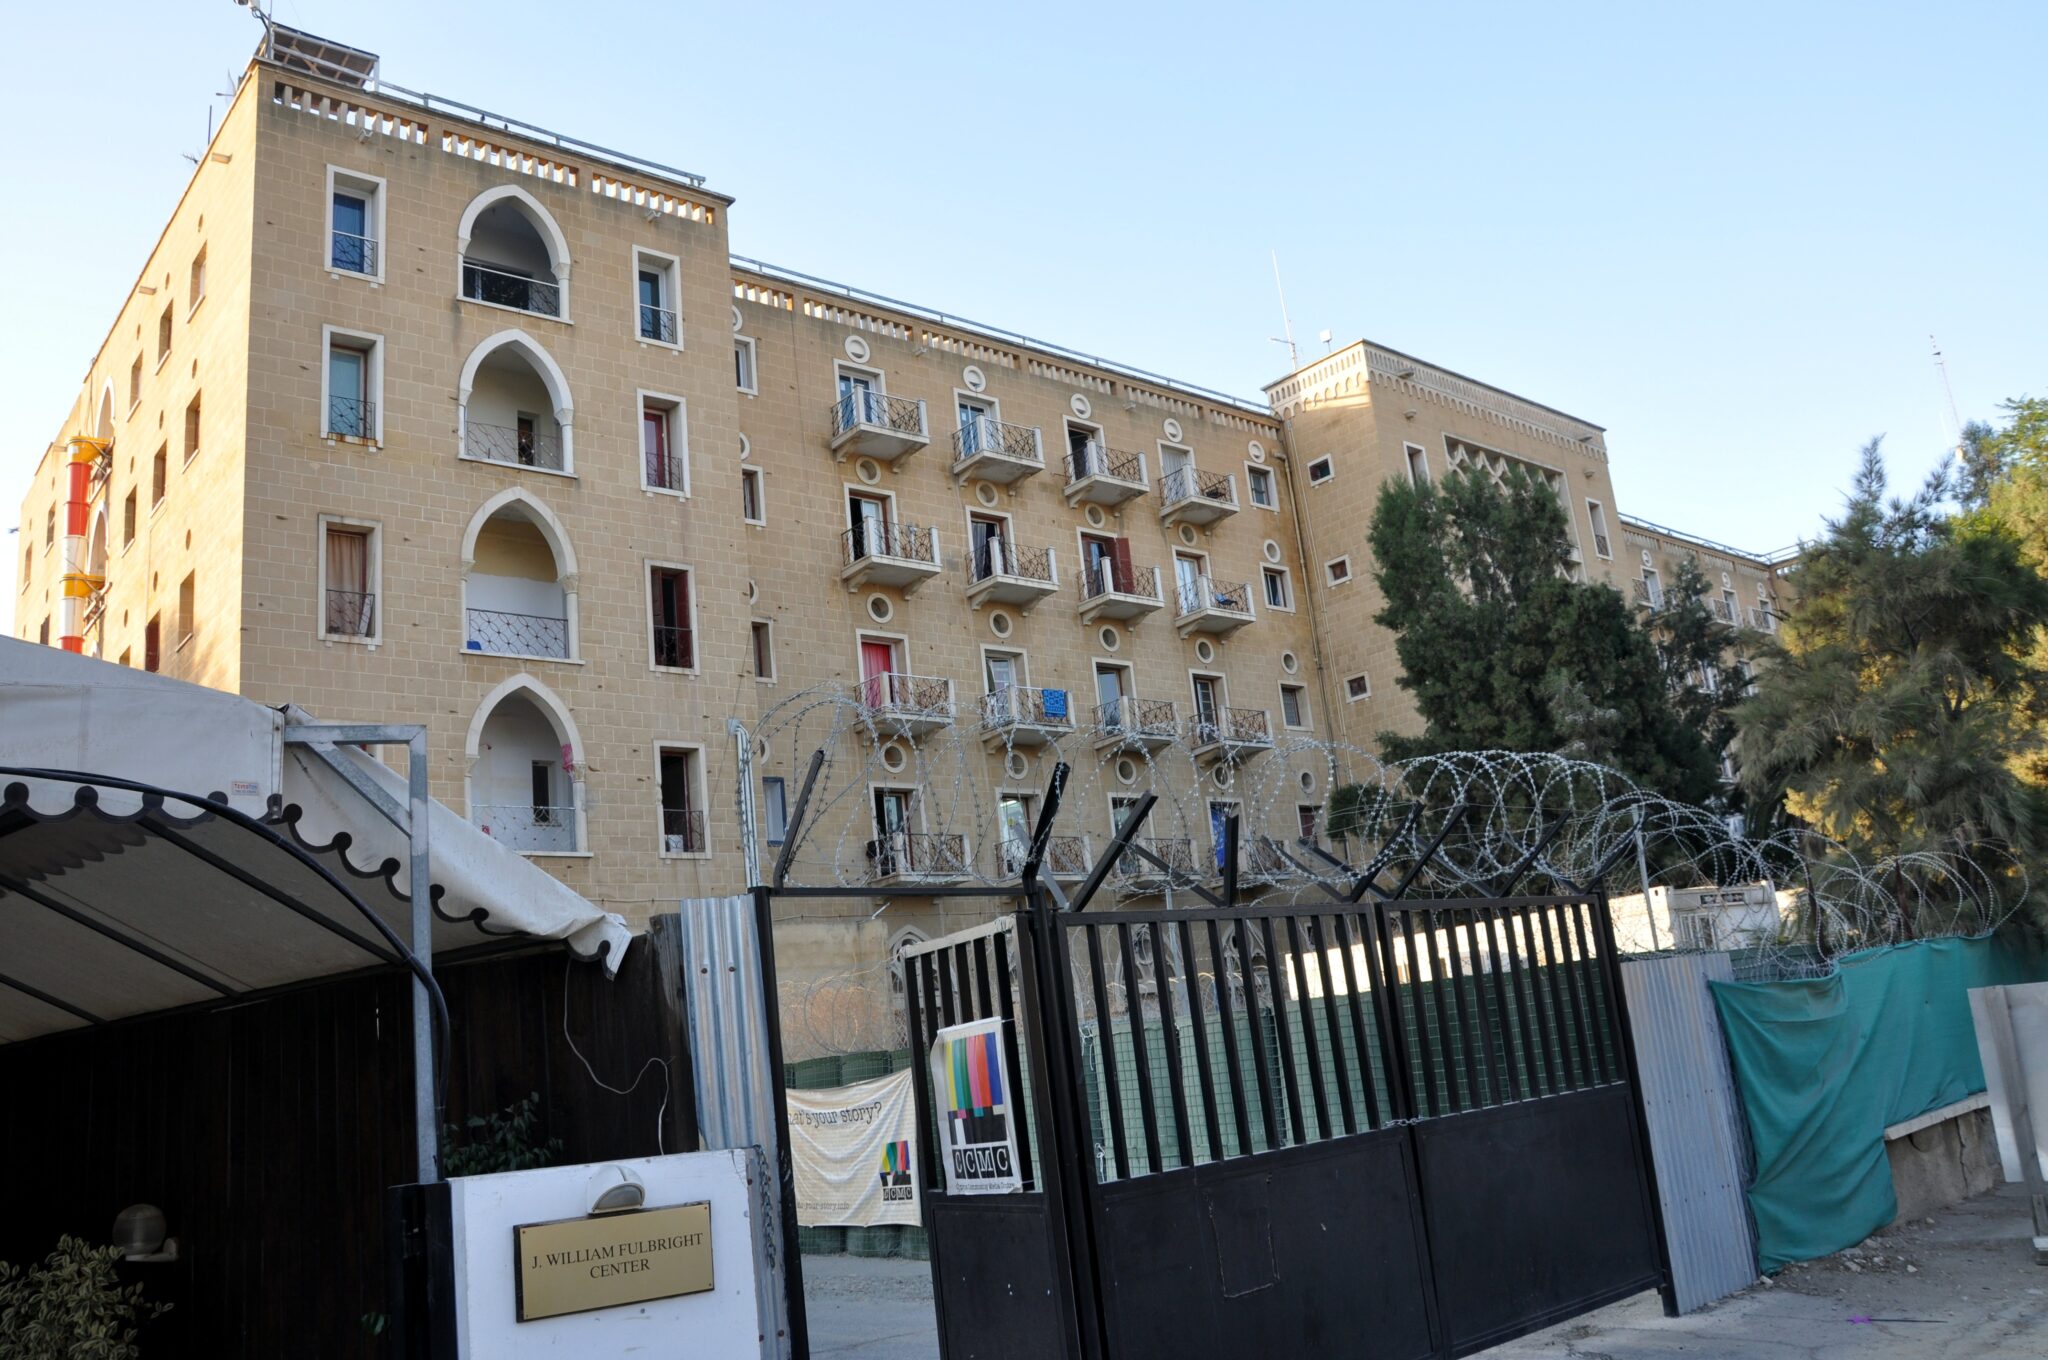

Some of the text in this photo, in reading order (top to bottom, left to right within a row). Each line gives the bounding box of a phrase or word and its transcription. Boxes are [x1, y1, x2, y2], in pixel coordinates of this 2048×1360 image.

[813, 1110, 838, 1128] your
[840, 1101, 882, 1124] story?
[955, 1147, 1009, 1174] CCMC
[884, 1187, 912, 1200] CCMC
[531, 1233, 703, 1269] J. WILLIAM FULBRIGHT
[590, 1259, 650, 1279] CENTER
